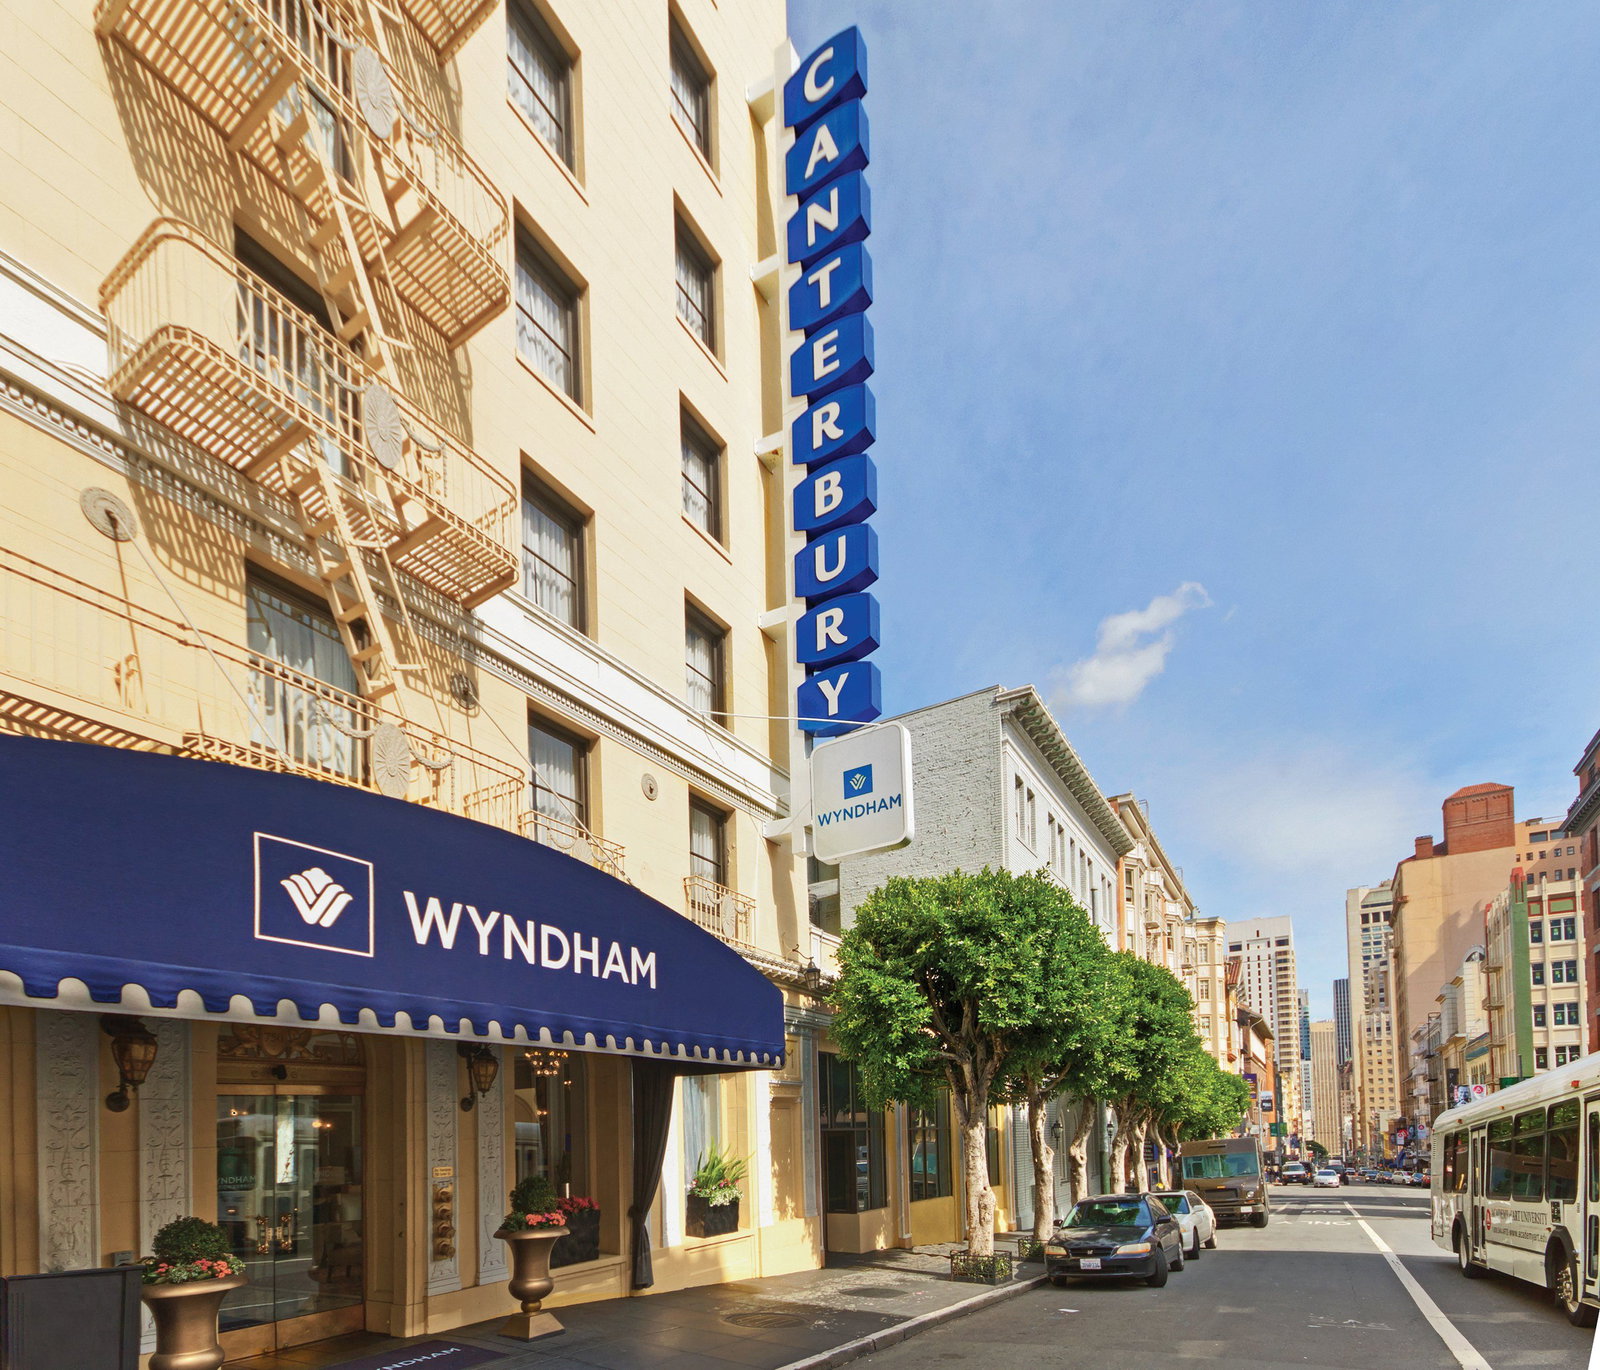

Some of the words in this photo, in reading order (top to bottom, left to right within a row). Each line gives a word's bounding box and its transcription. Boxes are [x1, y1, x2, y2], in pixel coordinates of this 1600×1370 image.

[804, 47, 850, 717] CANTERBURY
[817, 793, 902, 827] WYNDHAM
[403, 890, 657, 990] WYNDHAM
[1520, 1210, 1548, 1225] UNIVERSITY
[376, 1347, 461, 1370] NDHAM
